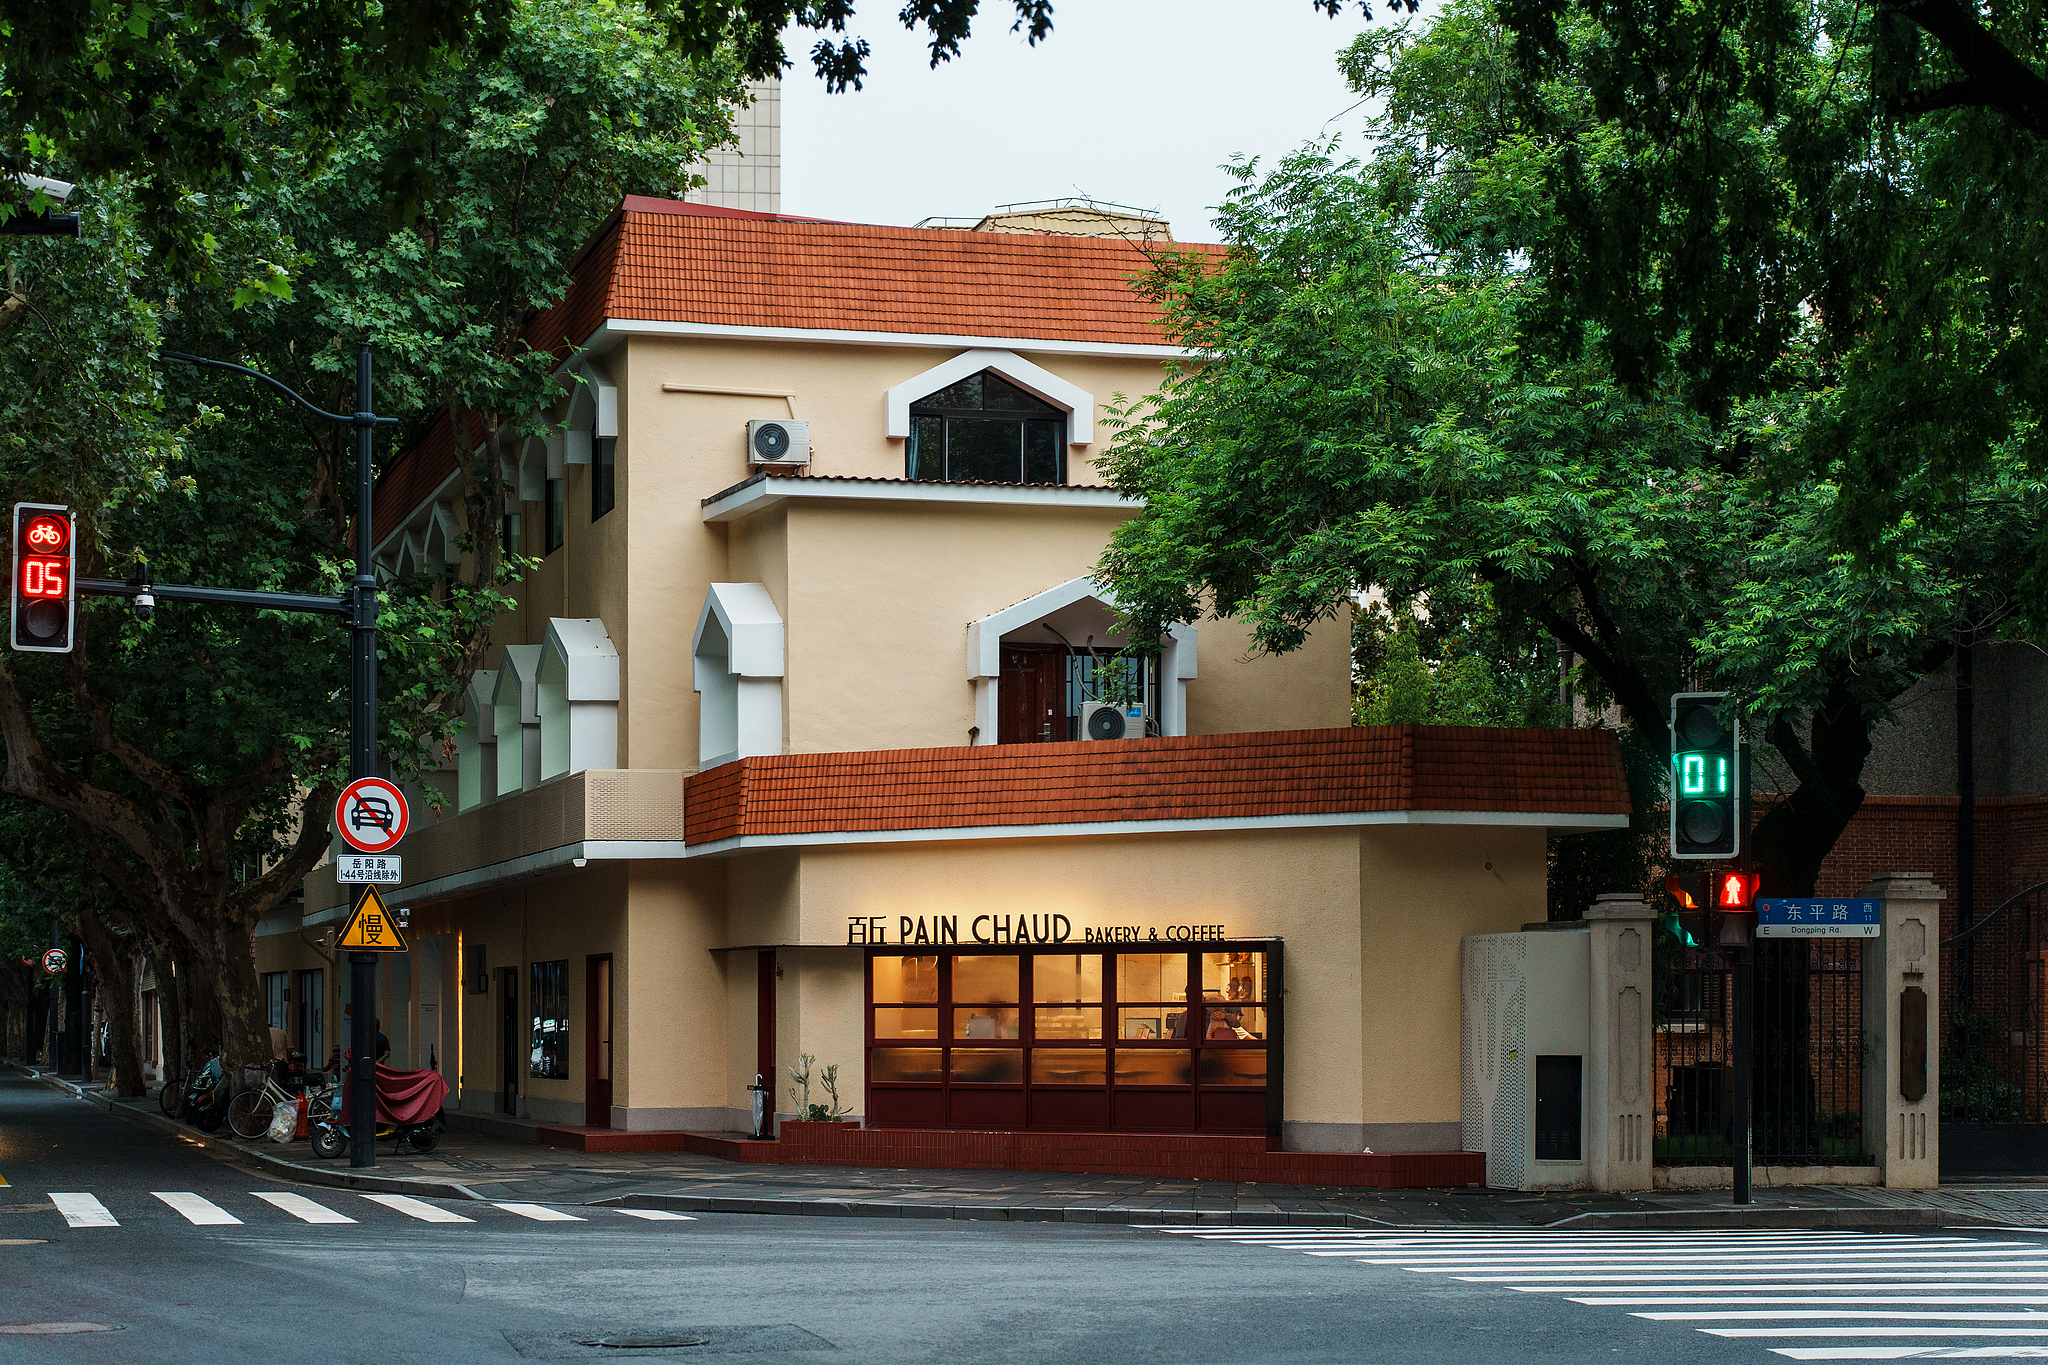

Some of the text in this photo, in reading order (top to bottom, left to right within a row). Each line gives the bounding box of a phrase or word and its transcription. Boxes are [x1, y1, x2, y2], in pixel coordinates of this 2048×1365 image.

[26, 561, 62, 594] 05
[1685, 756, 1725, 793] 01
[352, 858, 386, 869] 岳阳路
[1787, 904, 1848, 921] 东平路
[1863, 902, 1873, 913] 西
[358, 913, 383, 945] 慢
[900, 915, 958, 944] PAIN
[972, 914, 1071, 944] CHAUD
[1085, 926, 1140, 942] BAKERY
[1149, 927, 1158, 941] &
[1166, 925, 1224, 941] COFFEE
[1791, 926, 1826, 935] Dongping
[1829, 926, 1841, 934] Rd.
